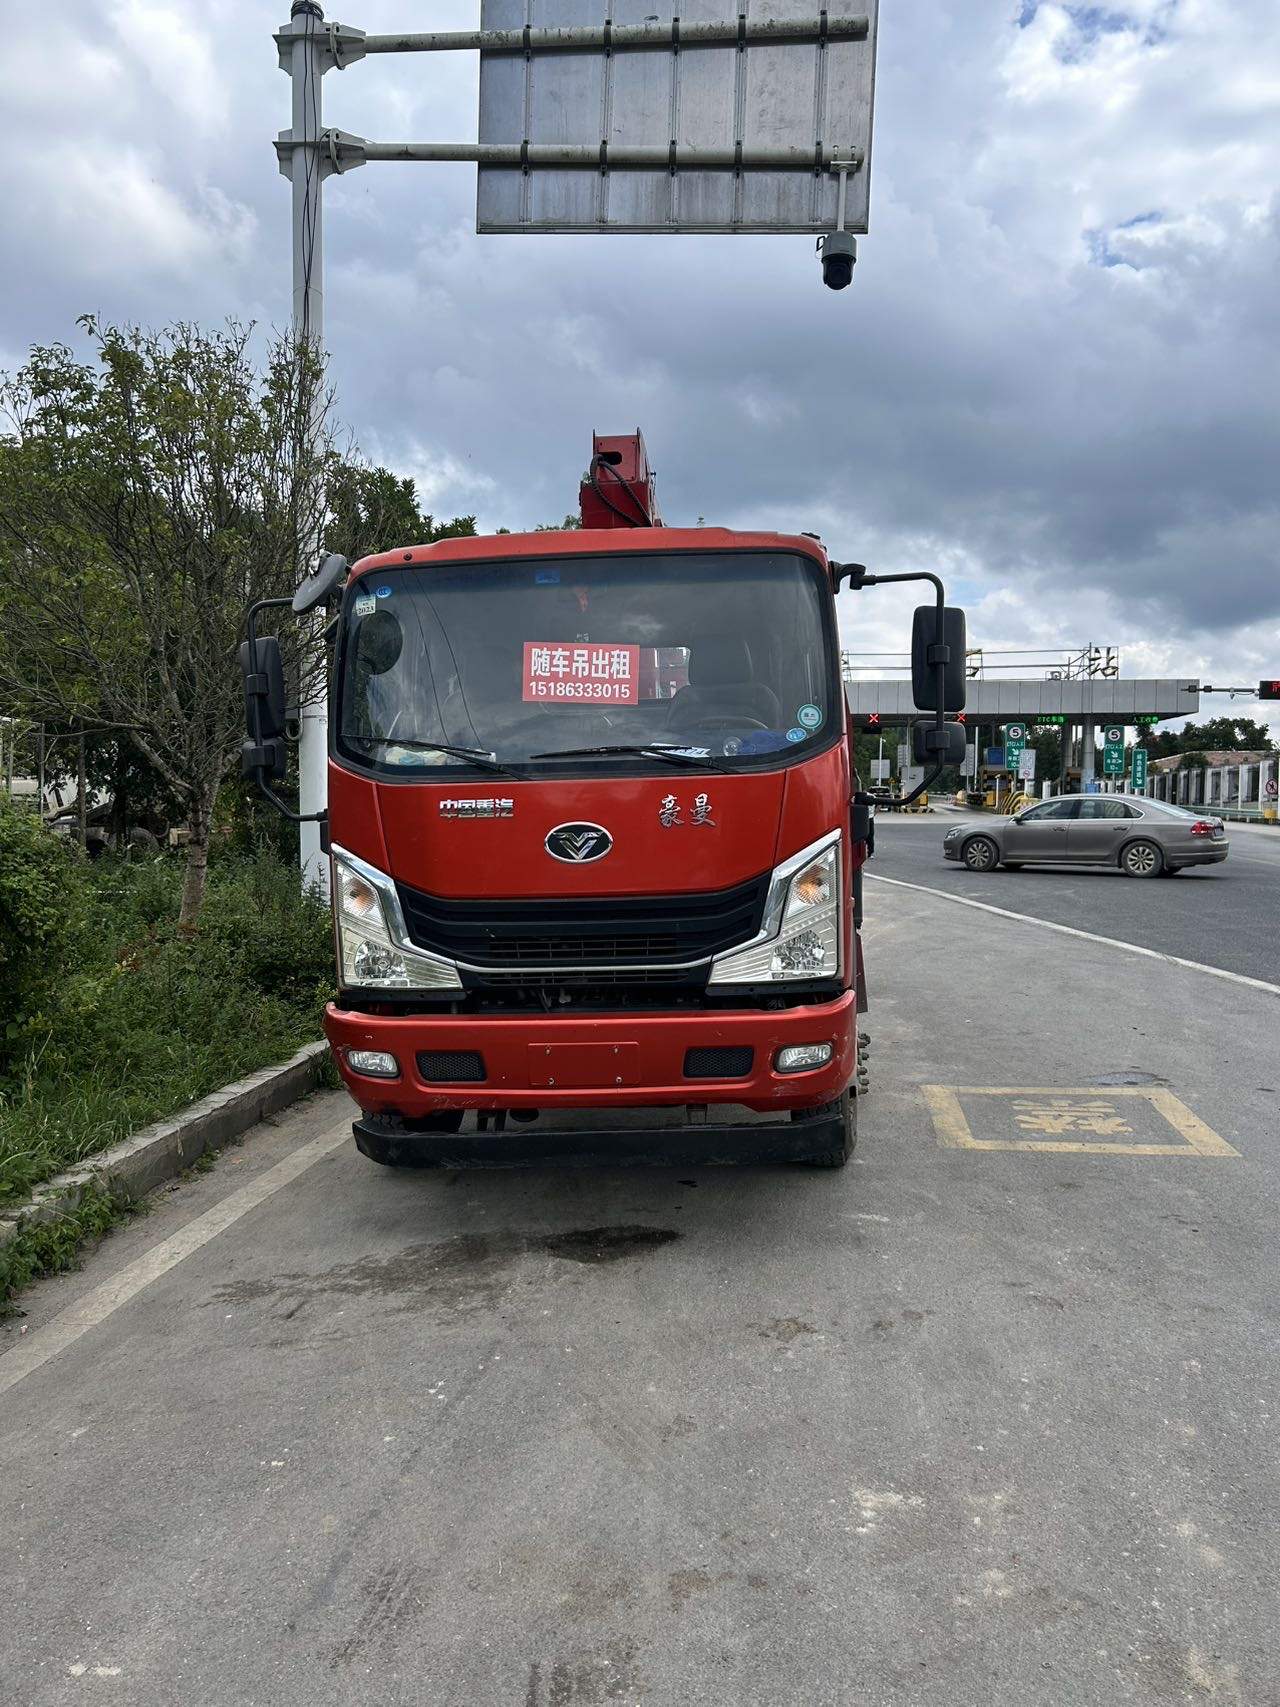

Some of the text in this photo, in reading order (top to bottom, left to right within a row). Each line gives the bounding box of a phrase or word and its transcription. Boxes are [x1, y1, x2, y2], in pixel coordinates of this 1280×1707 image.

[530, 648, 631, 679] 随车吊出租
[529, 682, 631, 699] 15186333015
[439, 798, 514, 819] 中国重汽
[657, 793, 718, 828] 豪曼
